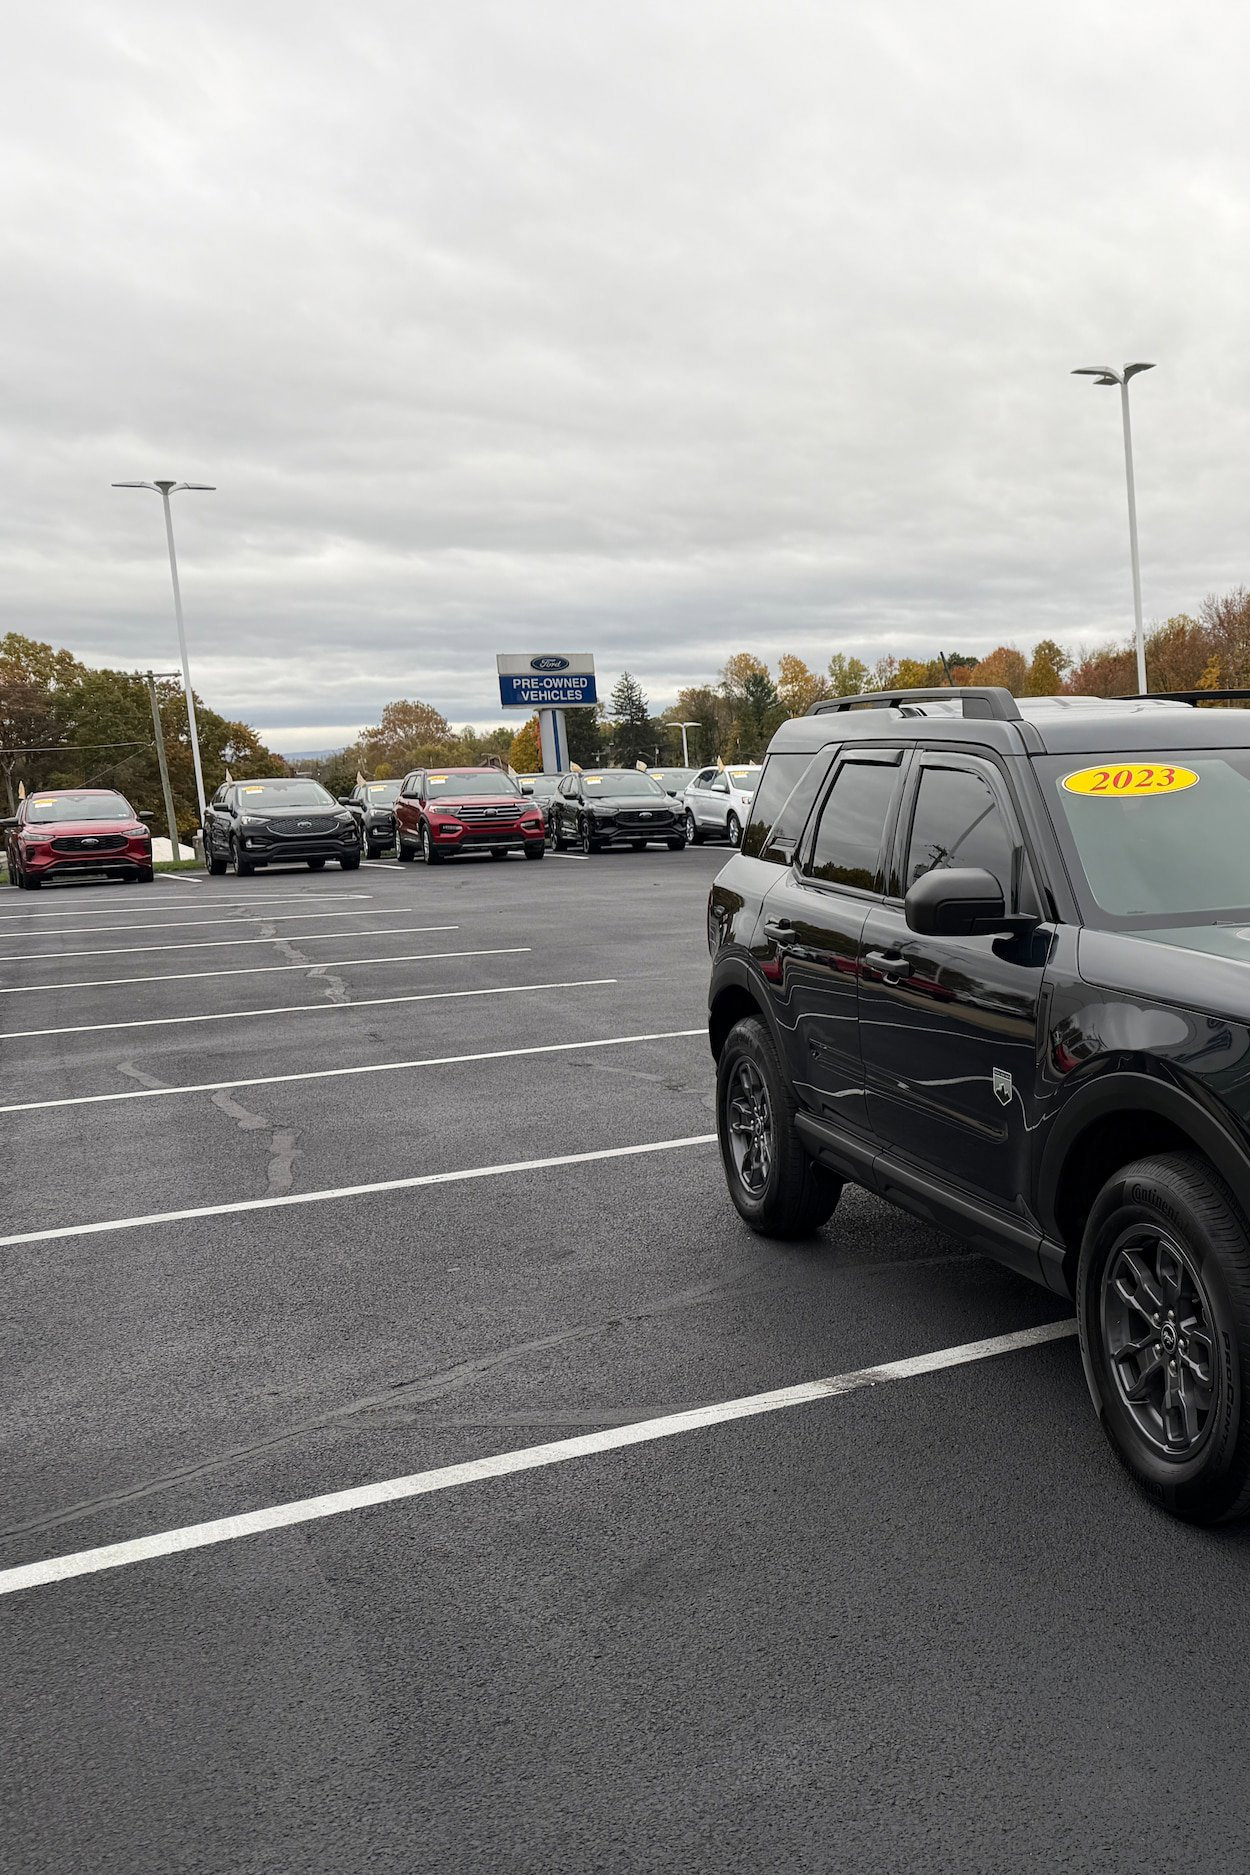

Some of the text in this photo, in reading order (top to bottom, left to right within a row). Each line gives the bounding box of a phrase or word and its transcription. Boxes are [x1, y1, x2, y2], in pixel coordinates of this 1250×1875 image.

[540, 658, 561, 668] Ford
[512, 678, 588, 689] PRE-OWNED
[521, 690, 583, 701] VEHICLES
[1090, 768, 1175, 791] 2023
